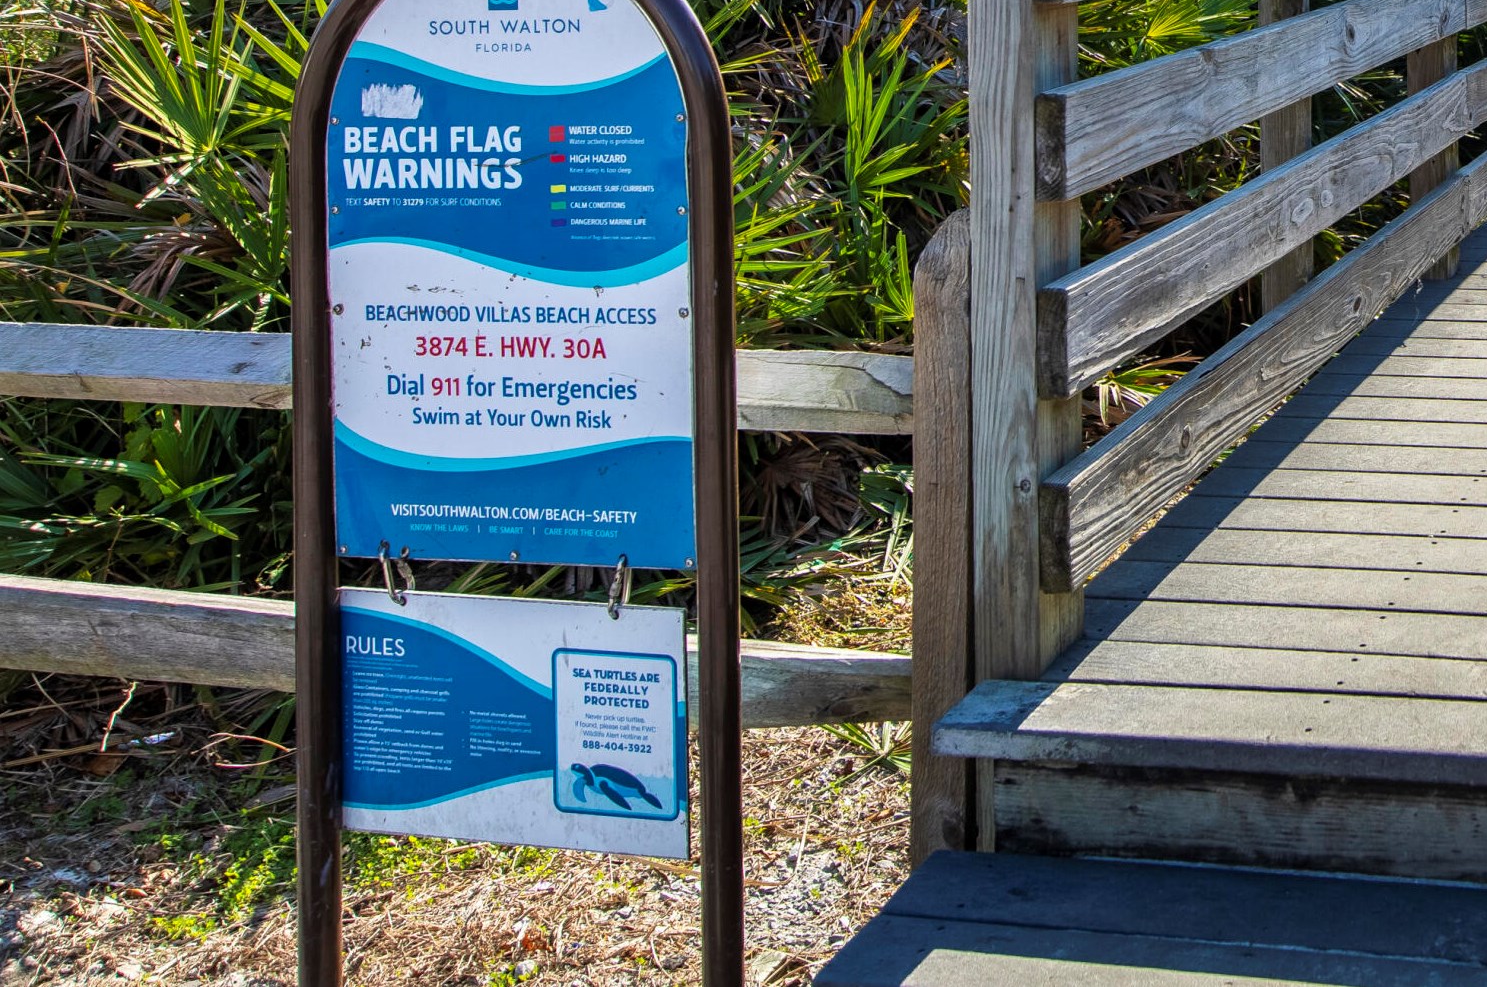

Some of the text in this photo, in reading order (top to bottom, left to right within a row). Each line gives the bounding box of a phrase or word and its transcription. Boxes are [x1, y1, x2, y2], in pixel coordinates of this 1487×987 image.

[429, 19, 581, 35] SOUTH WALTON
[476, 43, 532, 52] FLORIDA
[568, 126, 632, 135] WATER CLOSED
[344, 126, 522, 153] BEACH FLAG
[570, 154, 627, 163] HIGH HAZARD
[343, 158, 523, 189] WARNINGS
[345, 198, 501, 206] TEXT SAFETY TO 31279 FOR SURF CONDITIONS
[365, 305, 656, 325] BEACHWOOD VILLAS BEACH ACCESS
[415, 337, 607, 359] 3874 E. HWY. 30A
[387, 374, 637, 405] Dial 911 for Emergencies
[413, 408, 611, 428] Swim at Your Own Risk
[391, 504, 637, 524] VISITSOUTHWALTON.COM/BEACH-SAFETY
[434, 524, 447, 532] THE
[499, 526, 523, 534] SMART
[544, 528, 562, 536] CARE
[564, 528, 578, 536] FOR
[580, 529, 593, 537] THE
[595, 530, 618, 538] COAST
[347, 636, 405, 656] RULES
[573, 668, 660, 683] SEA TURTLES ARE
[584, 682, 648, 695] FEDERALLY
[584, 696, 649, 709] PROTECTED
[582, 740, 651, 753] 888-404-3922
